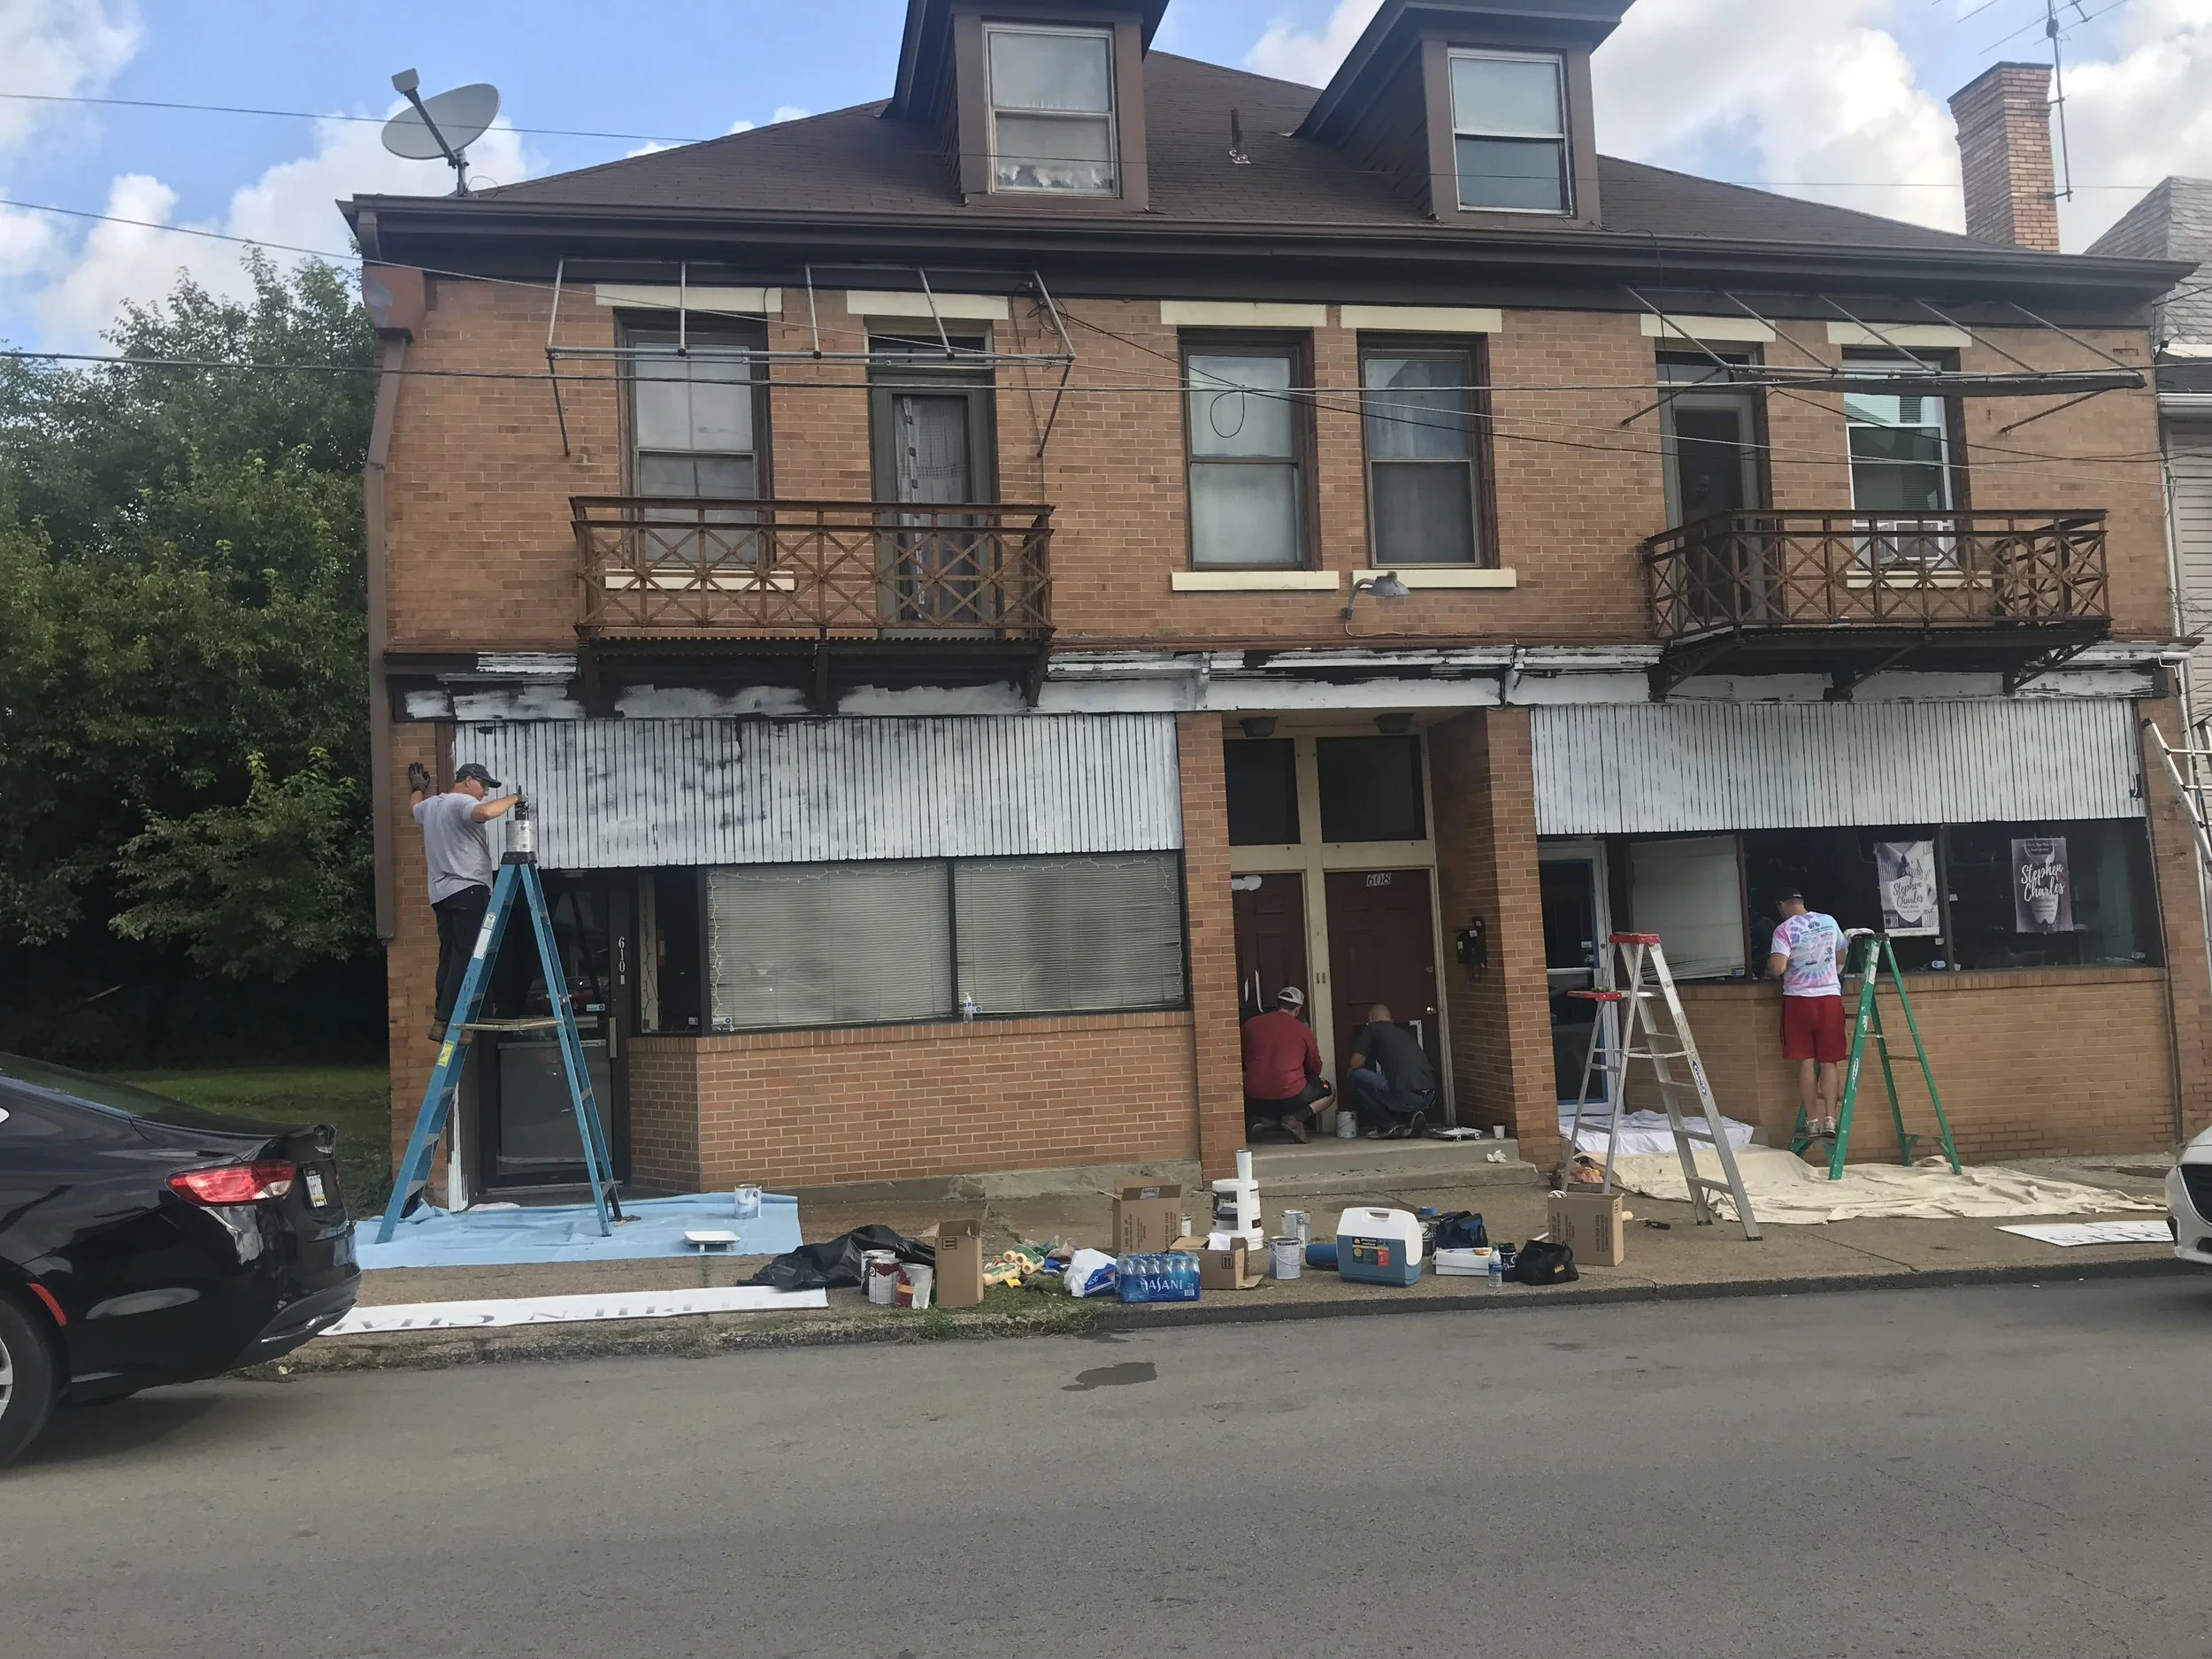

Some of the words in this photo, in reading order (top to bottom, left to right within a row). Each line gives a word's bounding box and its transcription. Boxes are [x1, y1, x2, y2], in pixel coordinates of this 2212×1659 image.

[1367, 873, 1391, 887] 608
[2021, 863, 2063, 886] Stephen
[1893, 878, 1923, 896] Stephen
[2024, 876, 2065, 902] Charles
[1896, 889, 1924, 907] Charles
